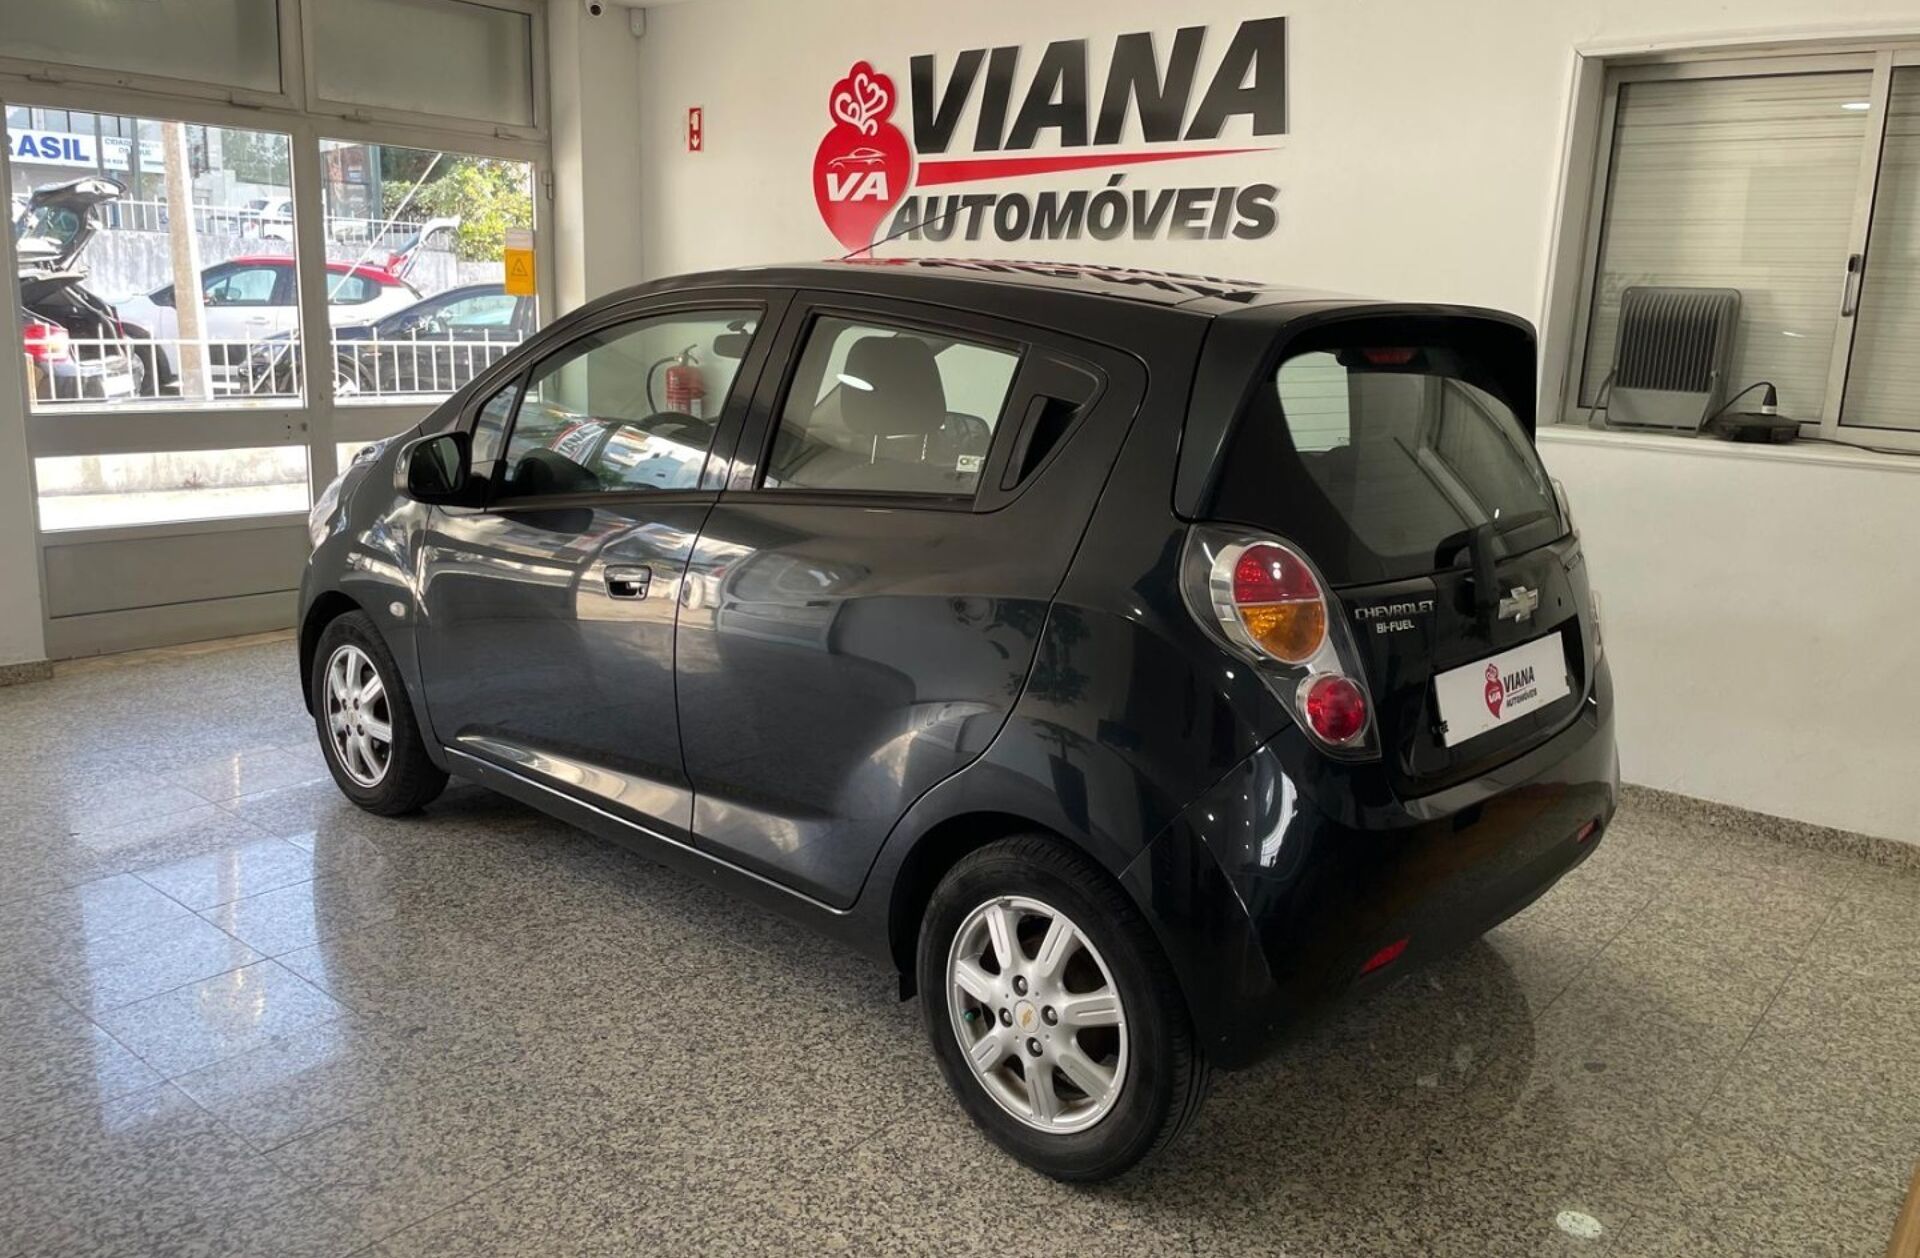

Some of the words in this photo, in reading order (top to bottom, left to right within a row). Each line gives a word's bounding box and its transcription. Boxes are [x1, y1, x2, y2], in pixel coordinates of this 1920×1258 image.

[909, 16, 1288, 155] VIANA
[826, 171, 889, 202] VA
[886, 173, 1281, 242] AUTOMÓVEIS
[1354, 600, 1434, 619] CHEVROLET
[1376, 620, 1415, 634] BI-FUEL
[1503, 666, 1536, 693] VIANA
